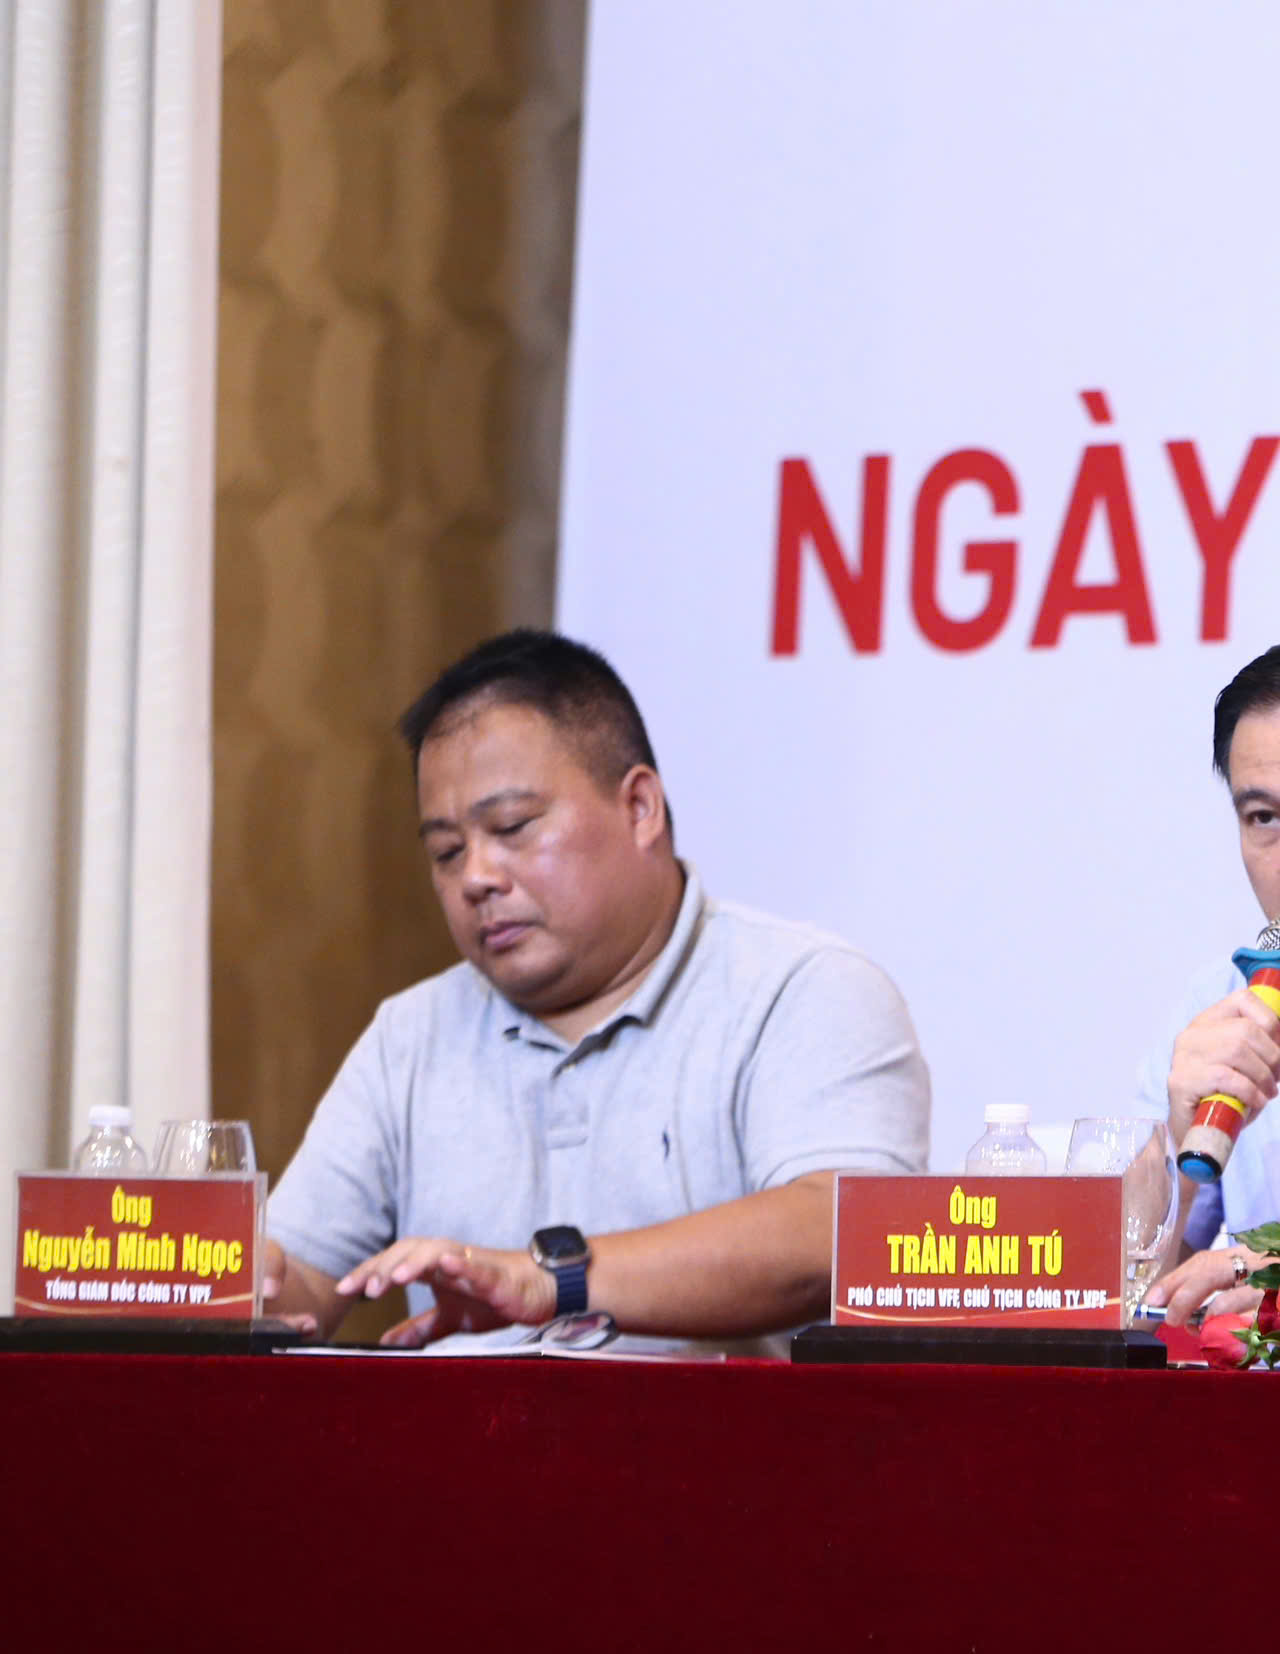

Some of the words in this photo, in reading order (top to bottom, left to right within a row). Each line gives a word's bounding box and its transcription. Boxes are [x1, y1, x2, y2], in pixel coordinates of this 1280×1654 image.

[111, 1185, 153, 1228] Ông
[949, 1184, 997, 1229] Ông
[117, 1232, 177, 1272] Minh
[182, 1234, 244, 1281] Ngọc
[887, 1222, 957, 1275] TRẦN
[963, 1235, 1020, 1276] ANH
[1027, 1230, 1063, 1276] TÚ
[172, 1284, 188, 1304] TY
[847, 1284, 874, 1308] PHÓ
[875, 1283, 903, 1308] CHỦ
[904, 1287, 936, 1311] TỊCH
[963, 1284, 991, 1309] CHỦ
[992, 1288, 1024, 1312] TỊCH
[1025, 1286, 1062, 1310] CÔNG
[1063, 1289, 1081, 1310] TY
[1082, 1289, 1107, 1310] VPF
